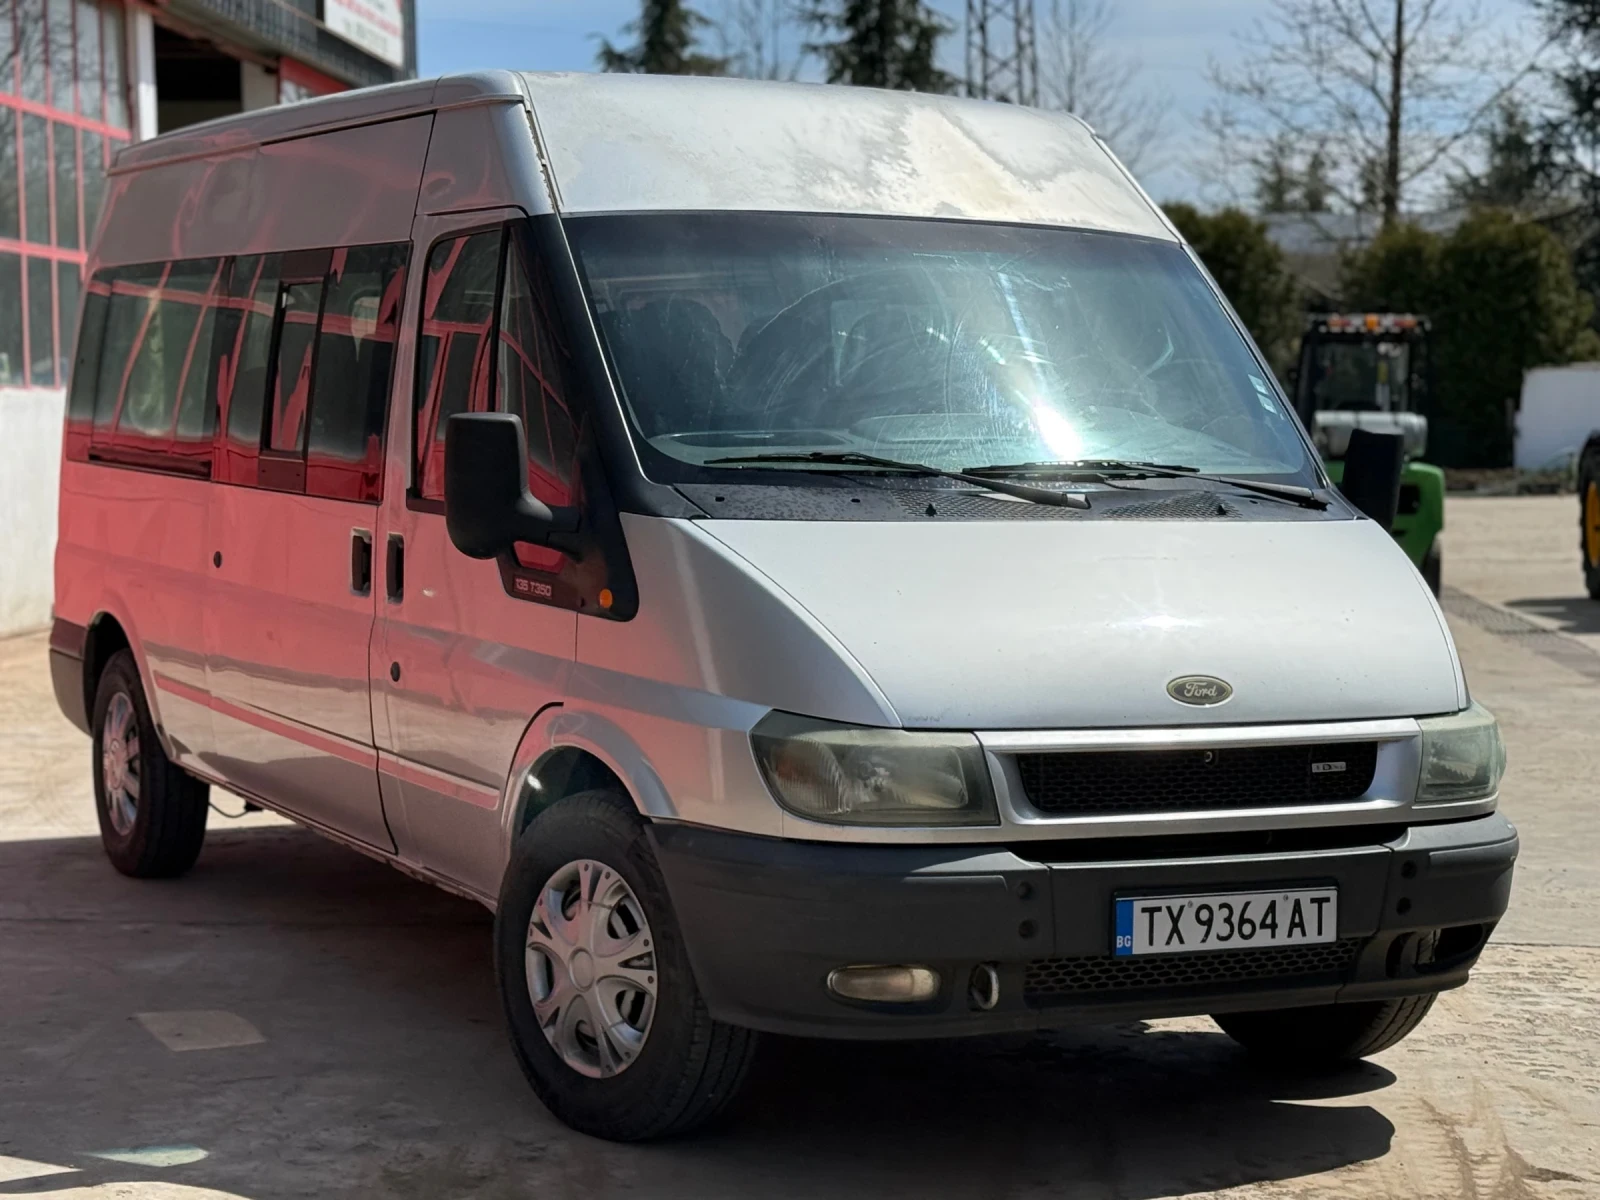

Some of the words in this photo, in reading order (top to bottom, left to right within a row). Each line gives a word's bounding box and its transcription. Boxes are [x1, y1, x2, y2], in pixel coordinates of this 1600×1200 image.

[530, 581, 552, 597] T350
[1184, 681, 1217, 697] Ford
[1141, 905, 1185, 946] TX
[1195, 900, 1279, 944] 9364
[1287, 896, 1331, 939] AT
[1116, 935, 1131, 949] BG
